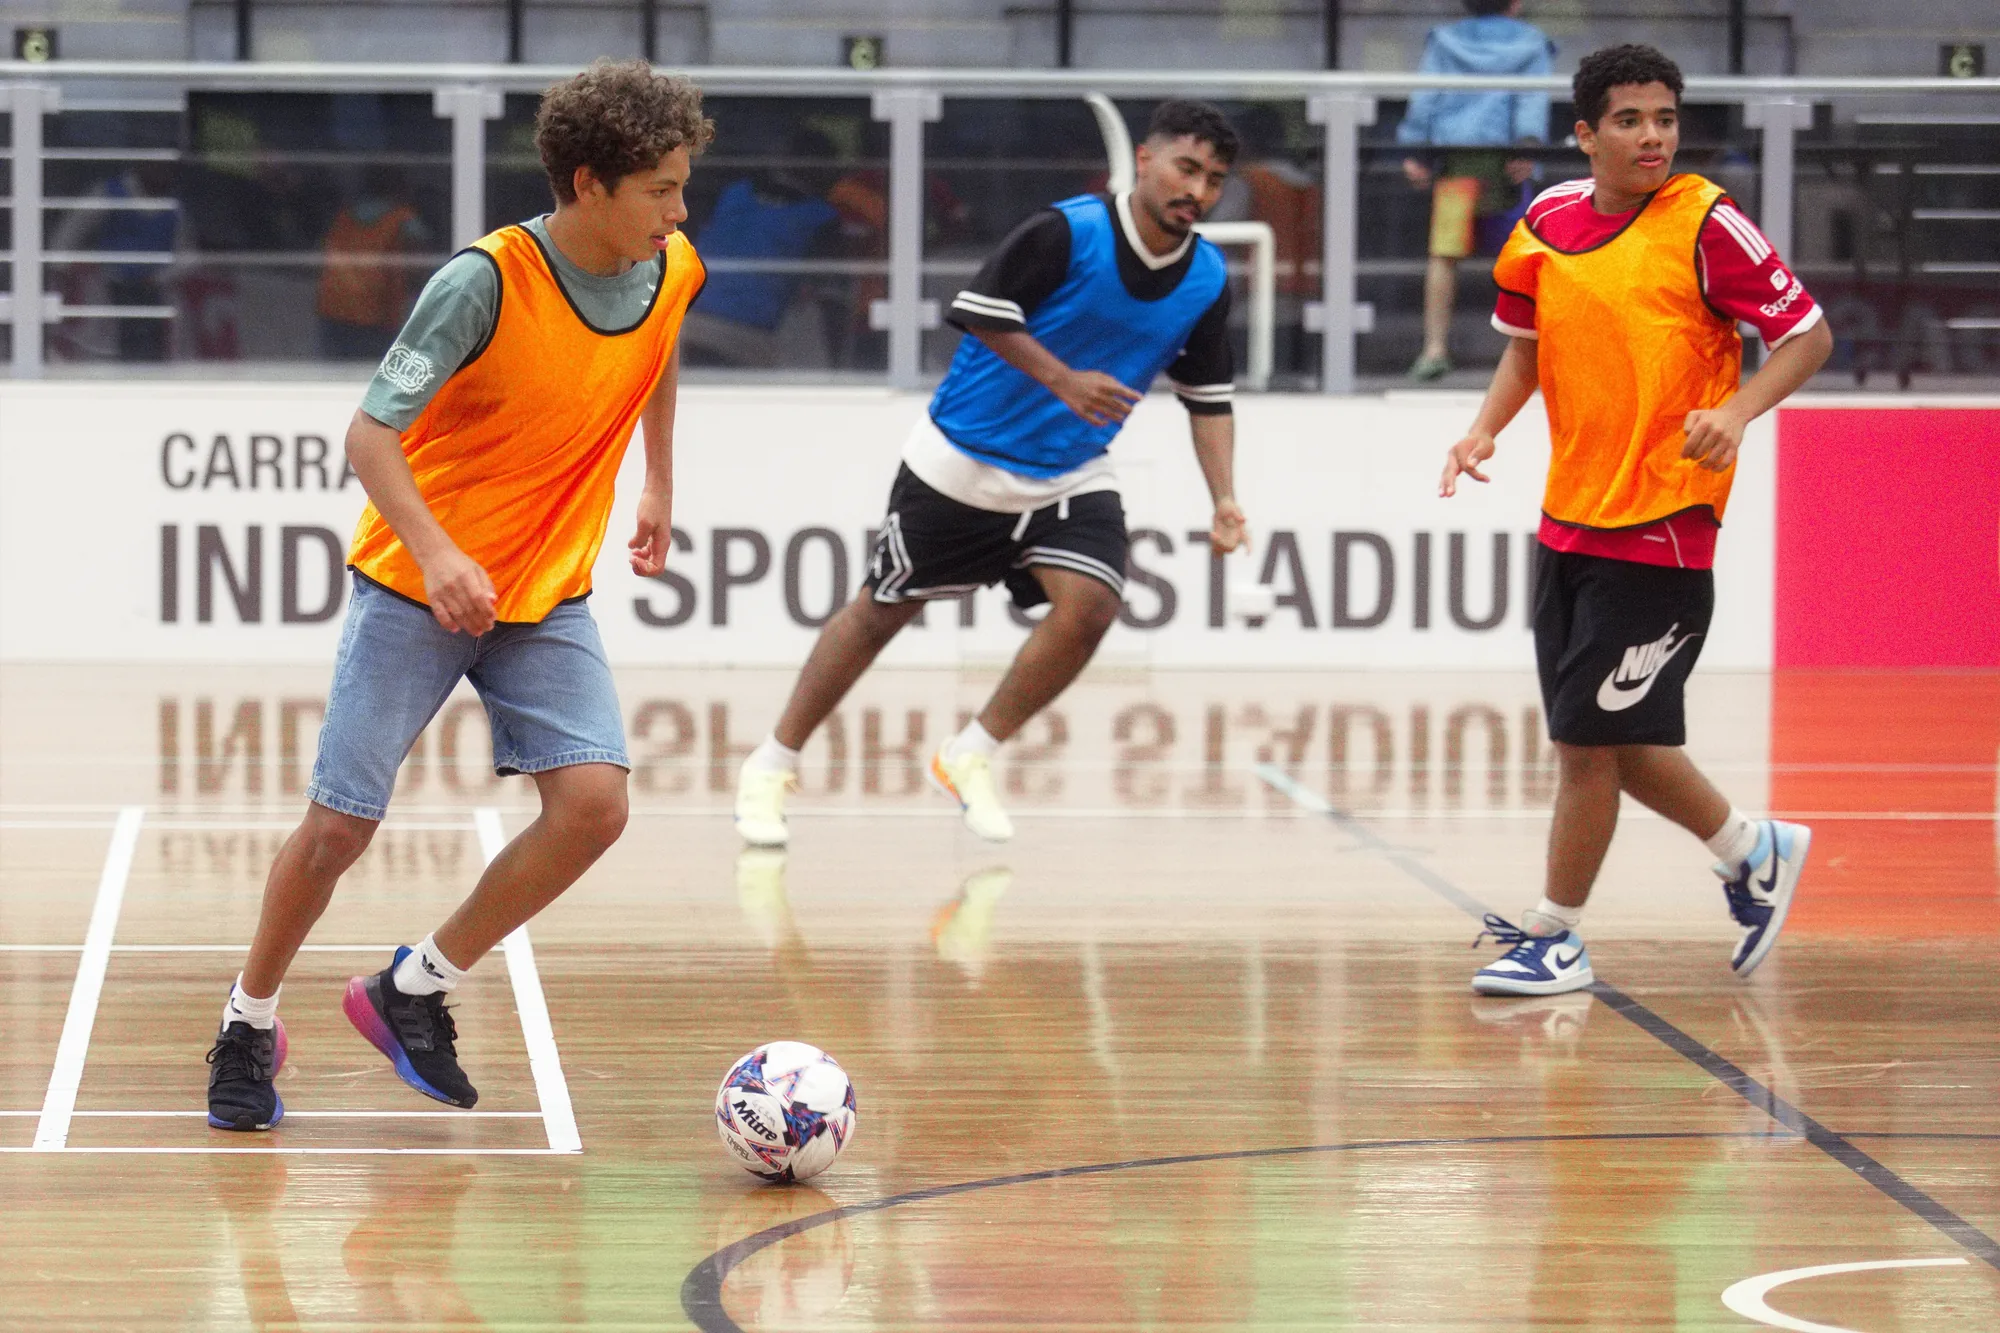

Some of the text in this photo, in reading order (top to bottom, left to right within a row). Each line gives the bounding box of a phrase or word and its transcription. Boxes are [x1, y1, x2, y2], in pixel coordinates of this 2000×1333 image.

[1759, 276, 1804, 317] Exped
[160, 433, 357, 489] CARR
[160, 524, 346, 624] IND
[1118, 528, 1538, 631] STADIU
[1615, 622, 1679, 683] NIKE
[732, 1100, 778, 1142] Mitre
